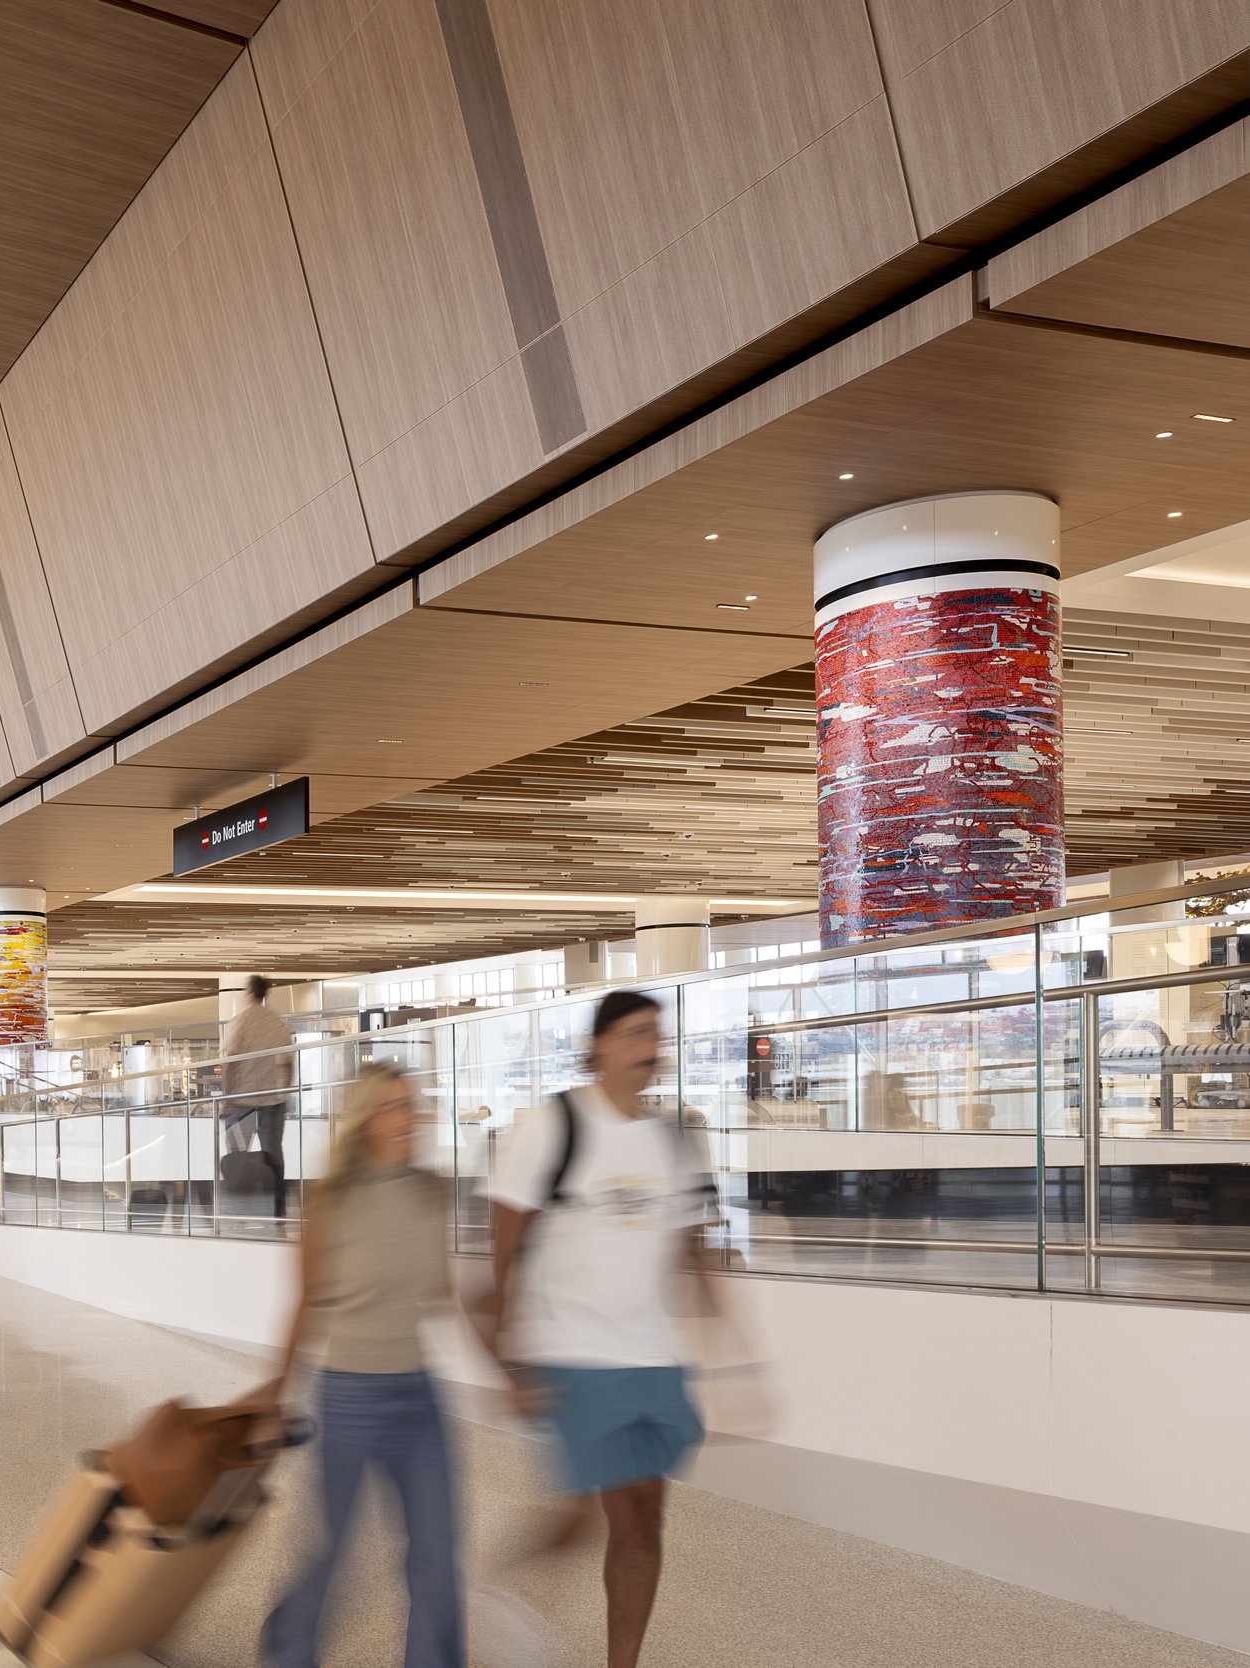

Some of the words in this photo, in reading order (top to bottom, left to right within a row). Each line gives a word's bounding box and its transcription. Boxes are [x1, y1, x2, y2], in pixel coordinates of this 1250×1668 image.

[212, 830, 222, 845] Do
[223, 824, 236, 841] Not
[237, 819, 255, 836] Enter
